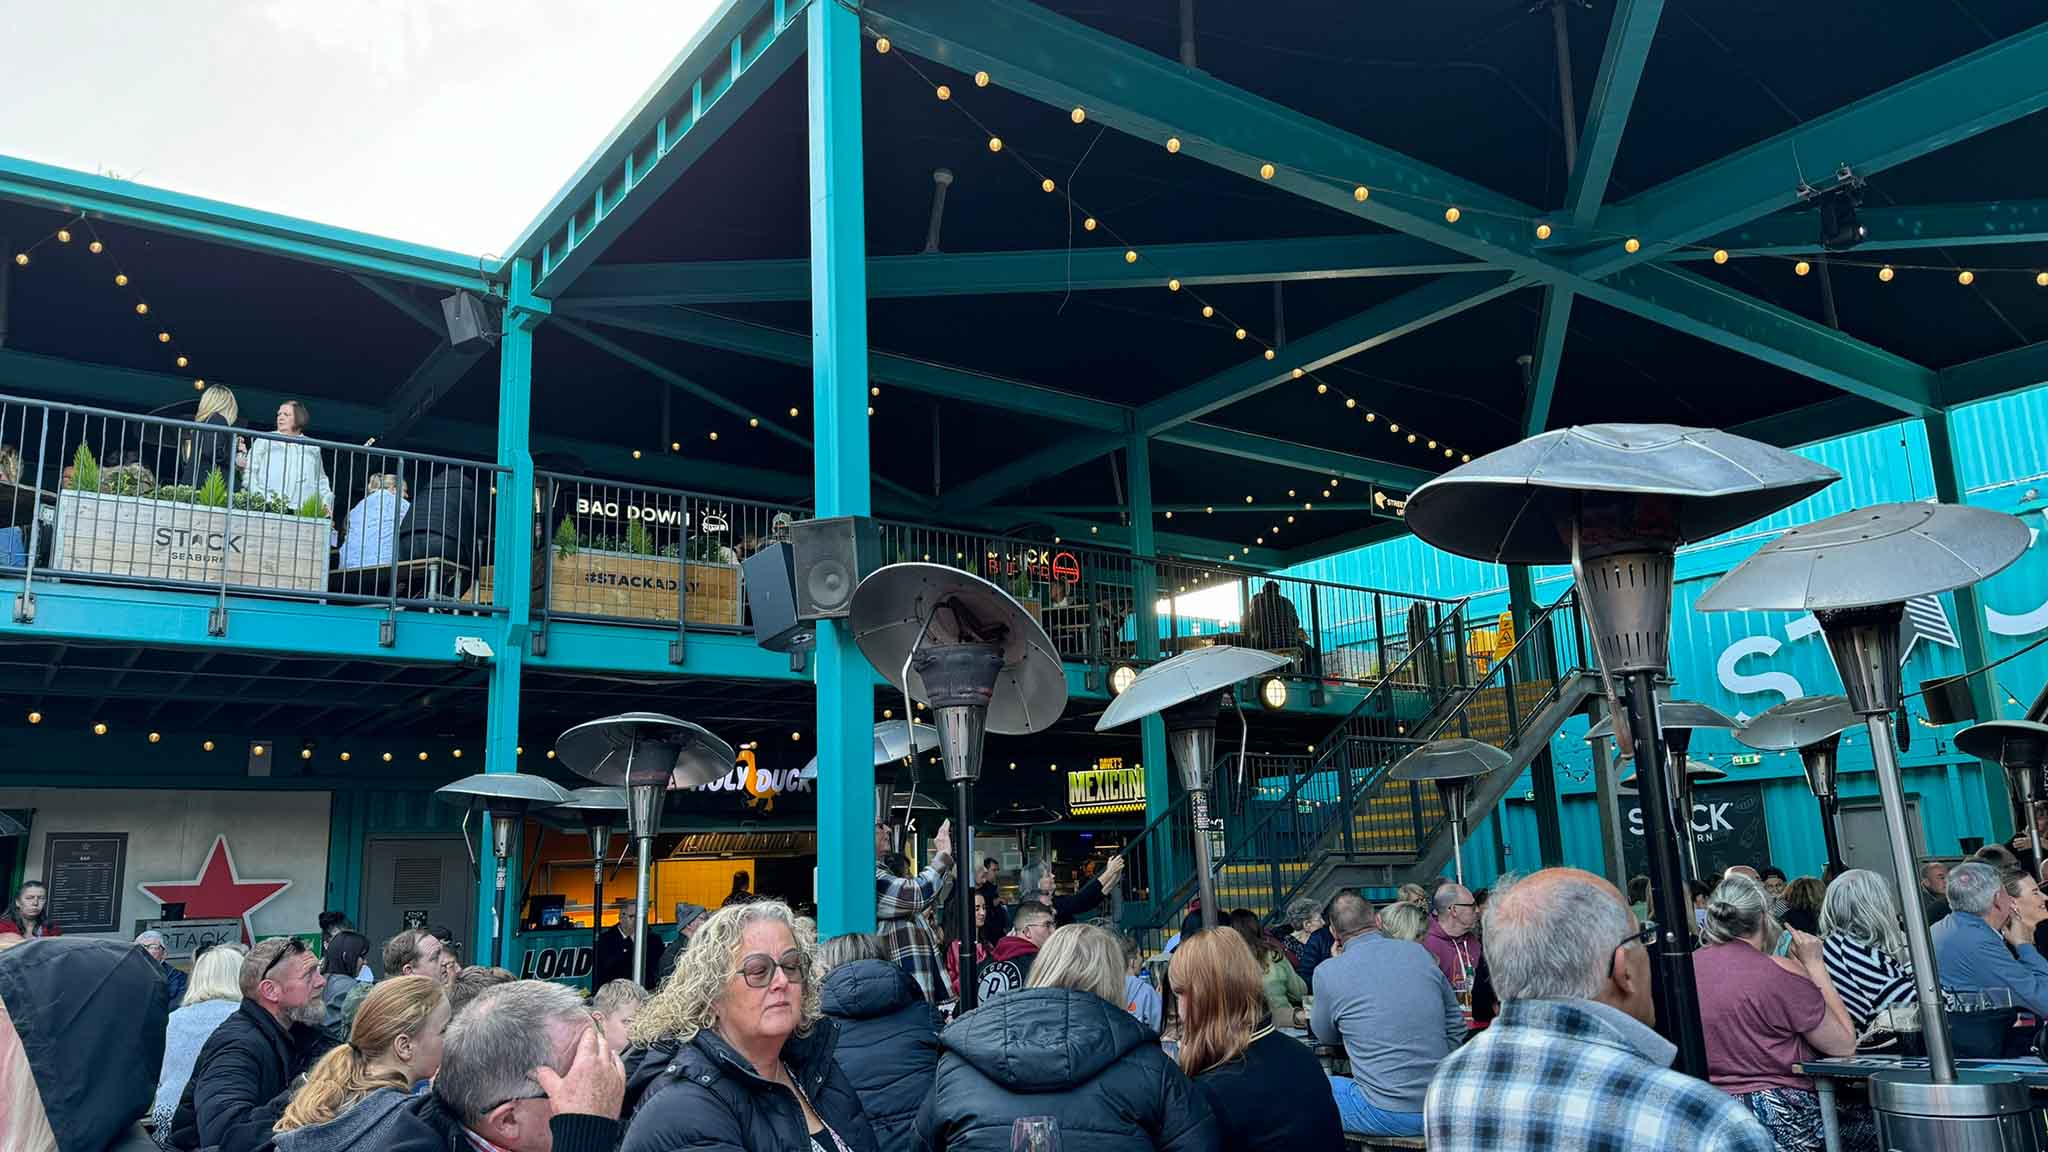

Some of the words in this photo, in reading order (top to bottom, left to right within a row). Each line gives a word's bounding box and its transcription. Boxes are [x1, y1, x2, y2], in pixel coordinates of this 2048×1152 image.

[576, 499, 618, 517] BAO
[627, 505, 690, 526] DOWN
[1628, 802, 1735, 835] SCK
